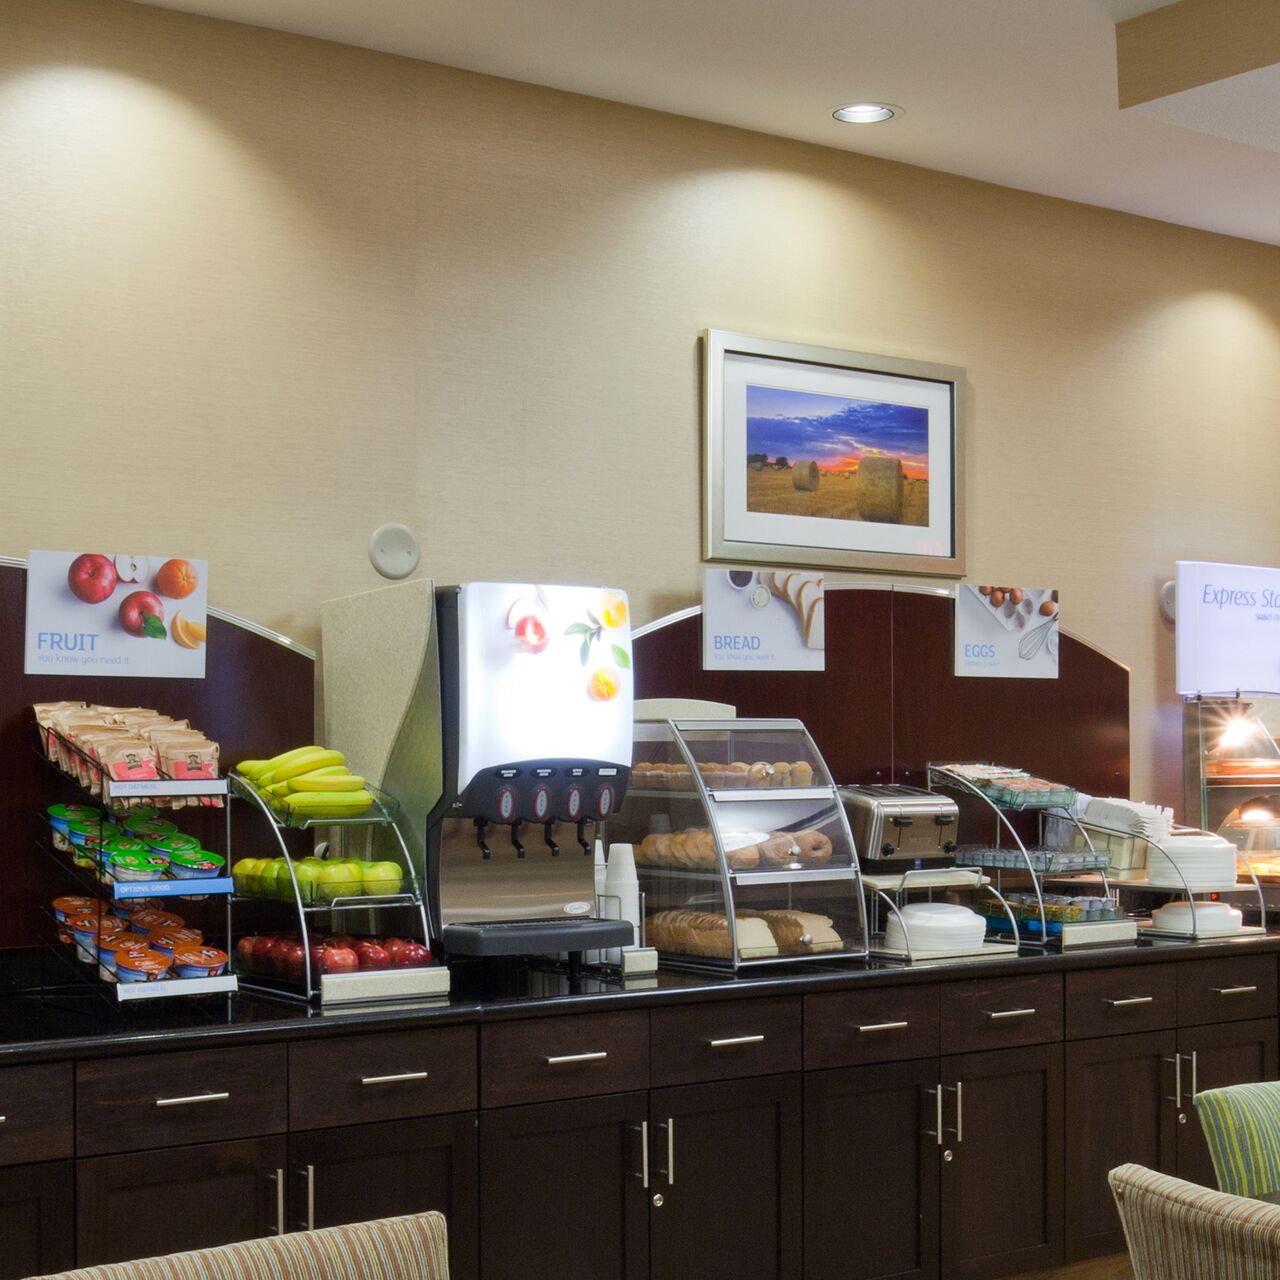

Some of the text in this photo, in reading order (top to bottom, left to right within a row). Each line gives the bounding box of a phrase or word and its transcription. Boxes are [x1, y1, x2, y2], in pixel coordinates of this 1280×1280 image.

[1203, 584, 1257, 609] Express
[37, 632, 99, 651] FRUIT
[713, 635, 761, 650] BREAD
[964, 644, 996, 658] EGGS
